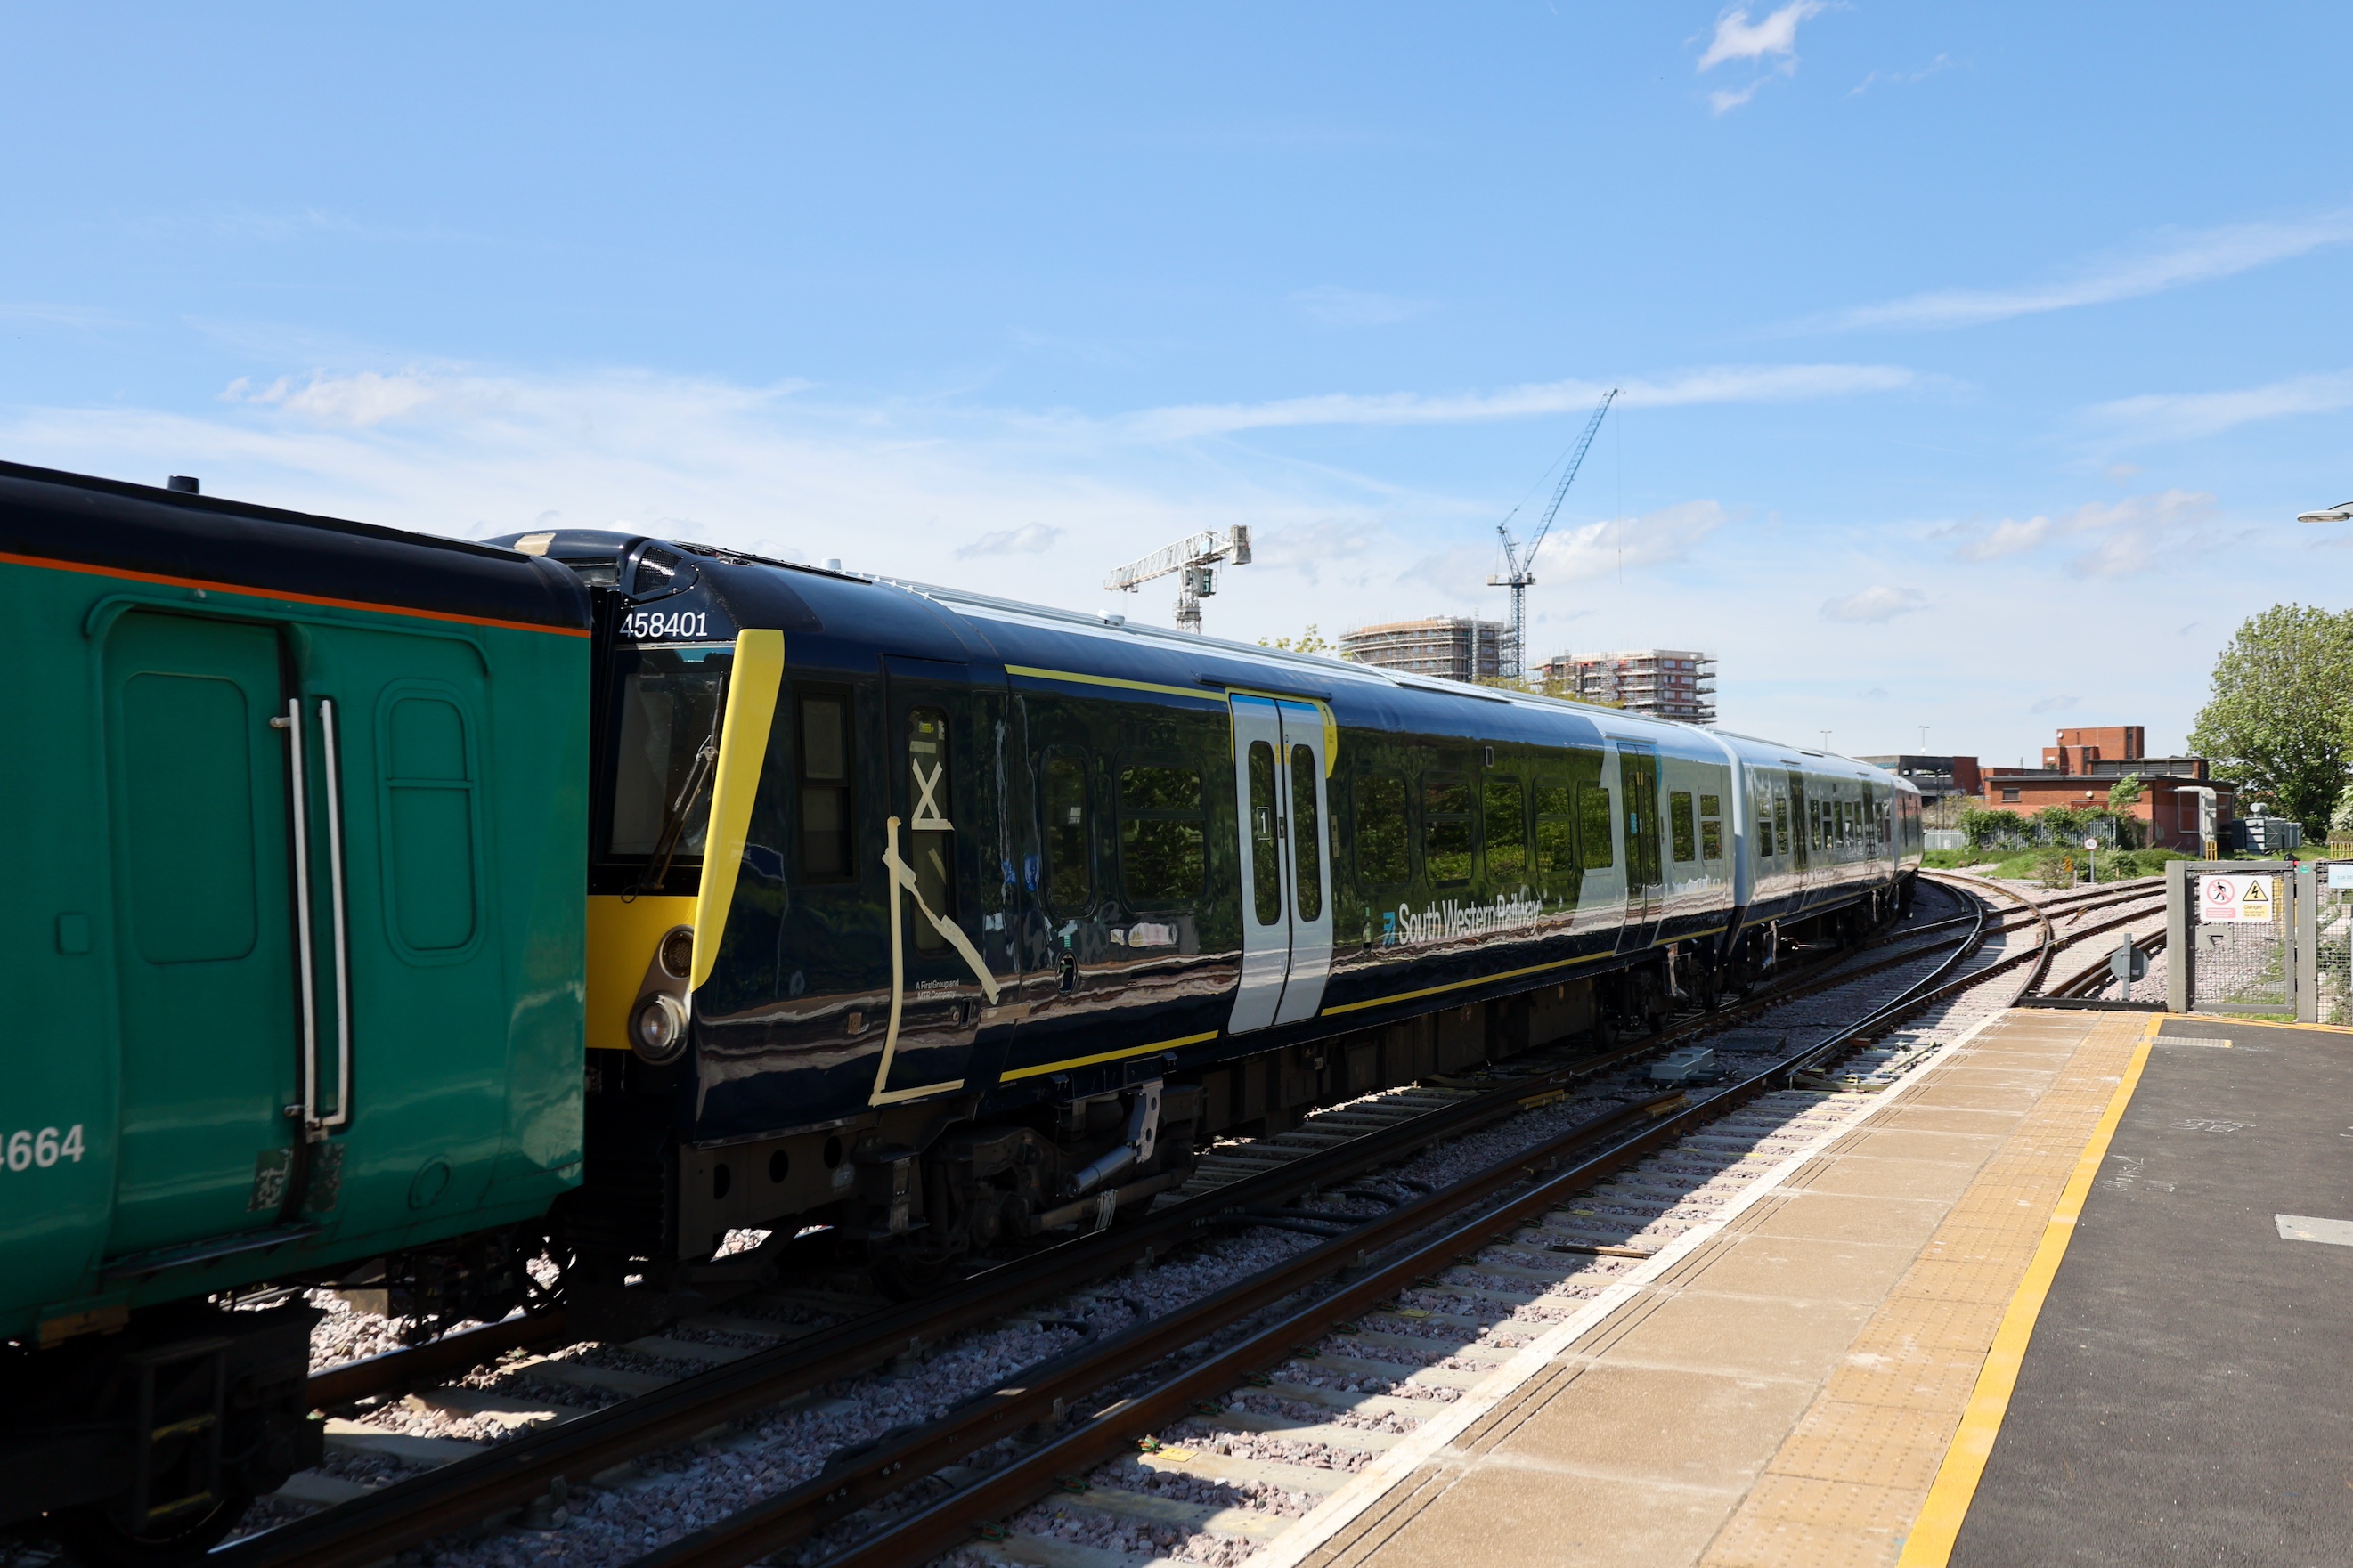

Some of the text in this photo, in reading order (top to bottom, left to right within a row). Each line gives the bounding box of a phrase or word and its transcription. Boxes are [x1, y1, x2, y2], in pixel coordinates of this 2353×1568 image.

[619, 612, 708, 638] 458401
[1260, 811, 1266, 834] 1
[1398, 893, 1542, 945] South Western Railway
[916, 978, 960, 990] A FirstGroup and
[917, 990, 957, 1000] MTR Company
[0, 1124, 85, 1172] 664
